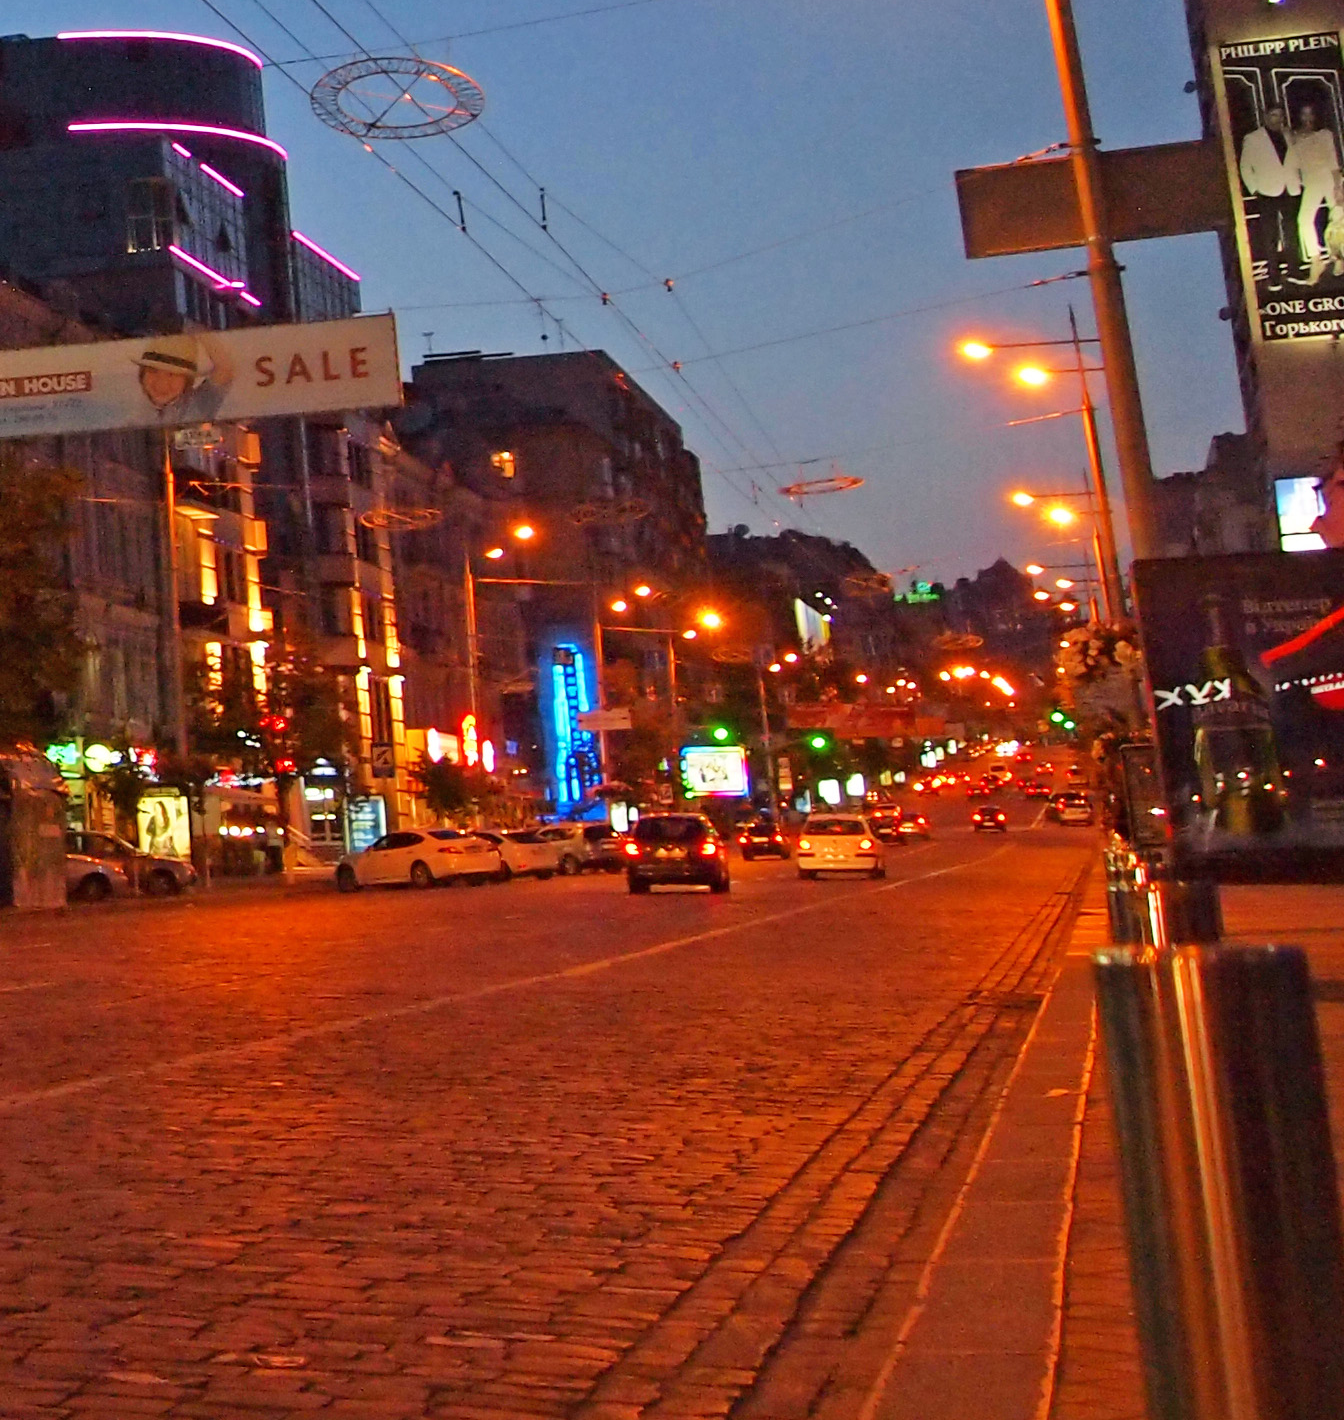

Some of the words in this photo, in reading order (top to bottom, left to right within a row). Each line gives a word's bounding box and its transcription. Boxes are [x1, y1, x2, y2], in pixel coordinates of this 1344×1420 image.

[1220, 41, 1286, 60] PHILIPP
[1288, 34, 1339, 53] PLEIN
[254, 346, 371, 388] SALE
[23, 373, 88, 394] HOUSE
